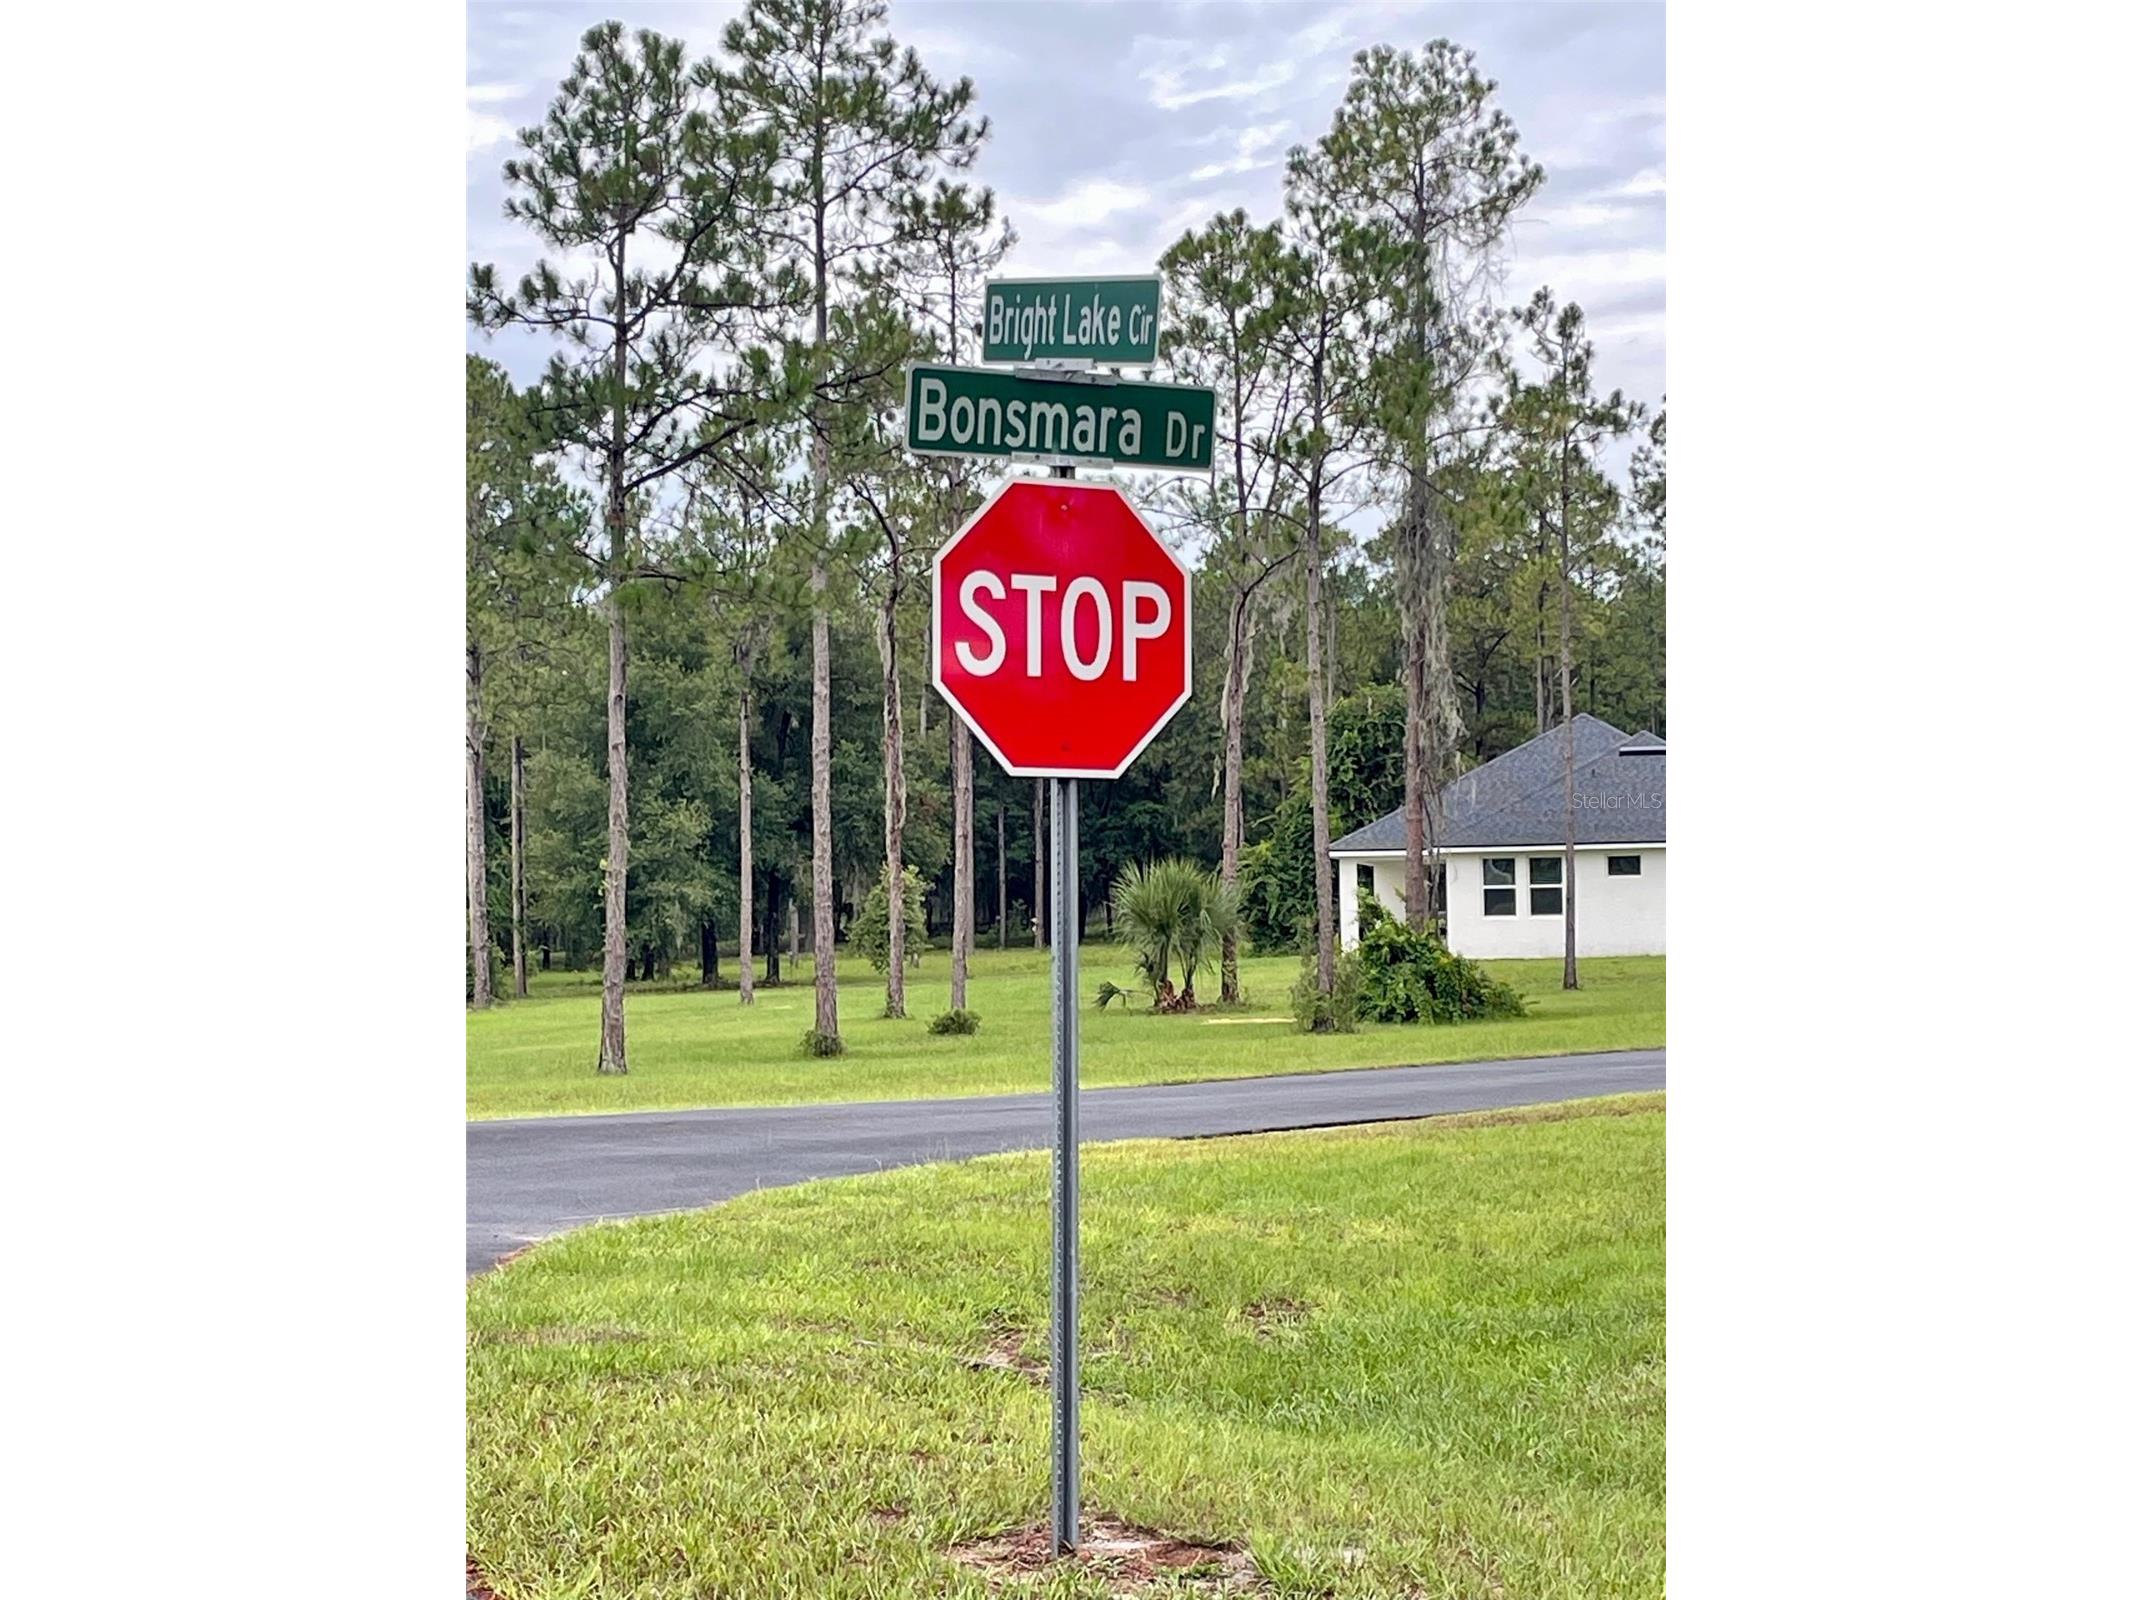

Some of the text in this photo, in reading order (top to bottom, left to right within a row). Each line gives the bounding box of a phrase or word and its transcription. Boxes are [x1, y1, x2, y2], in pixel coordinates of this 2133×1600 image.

[989, 293, 1153, 360] Bright Lake Cir
[917, 377, 1206, 459] Bonsmara Dr
[954, 569, 1172, 682] STOP
